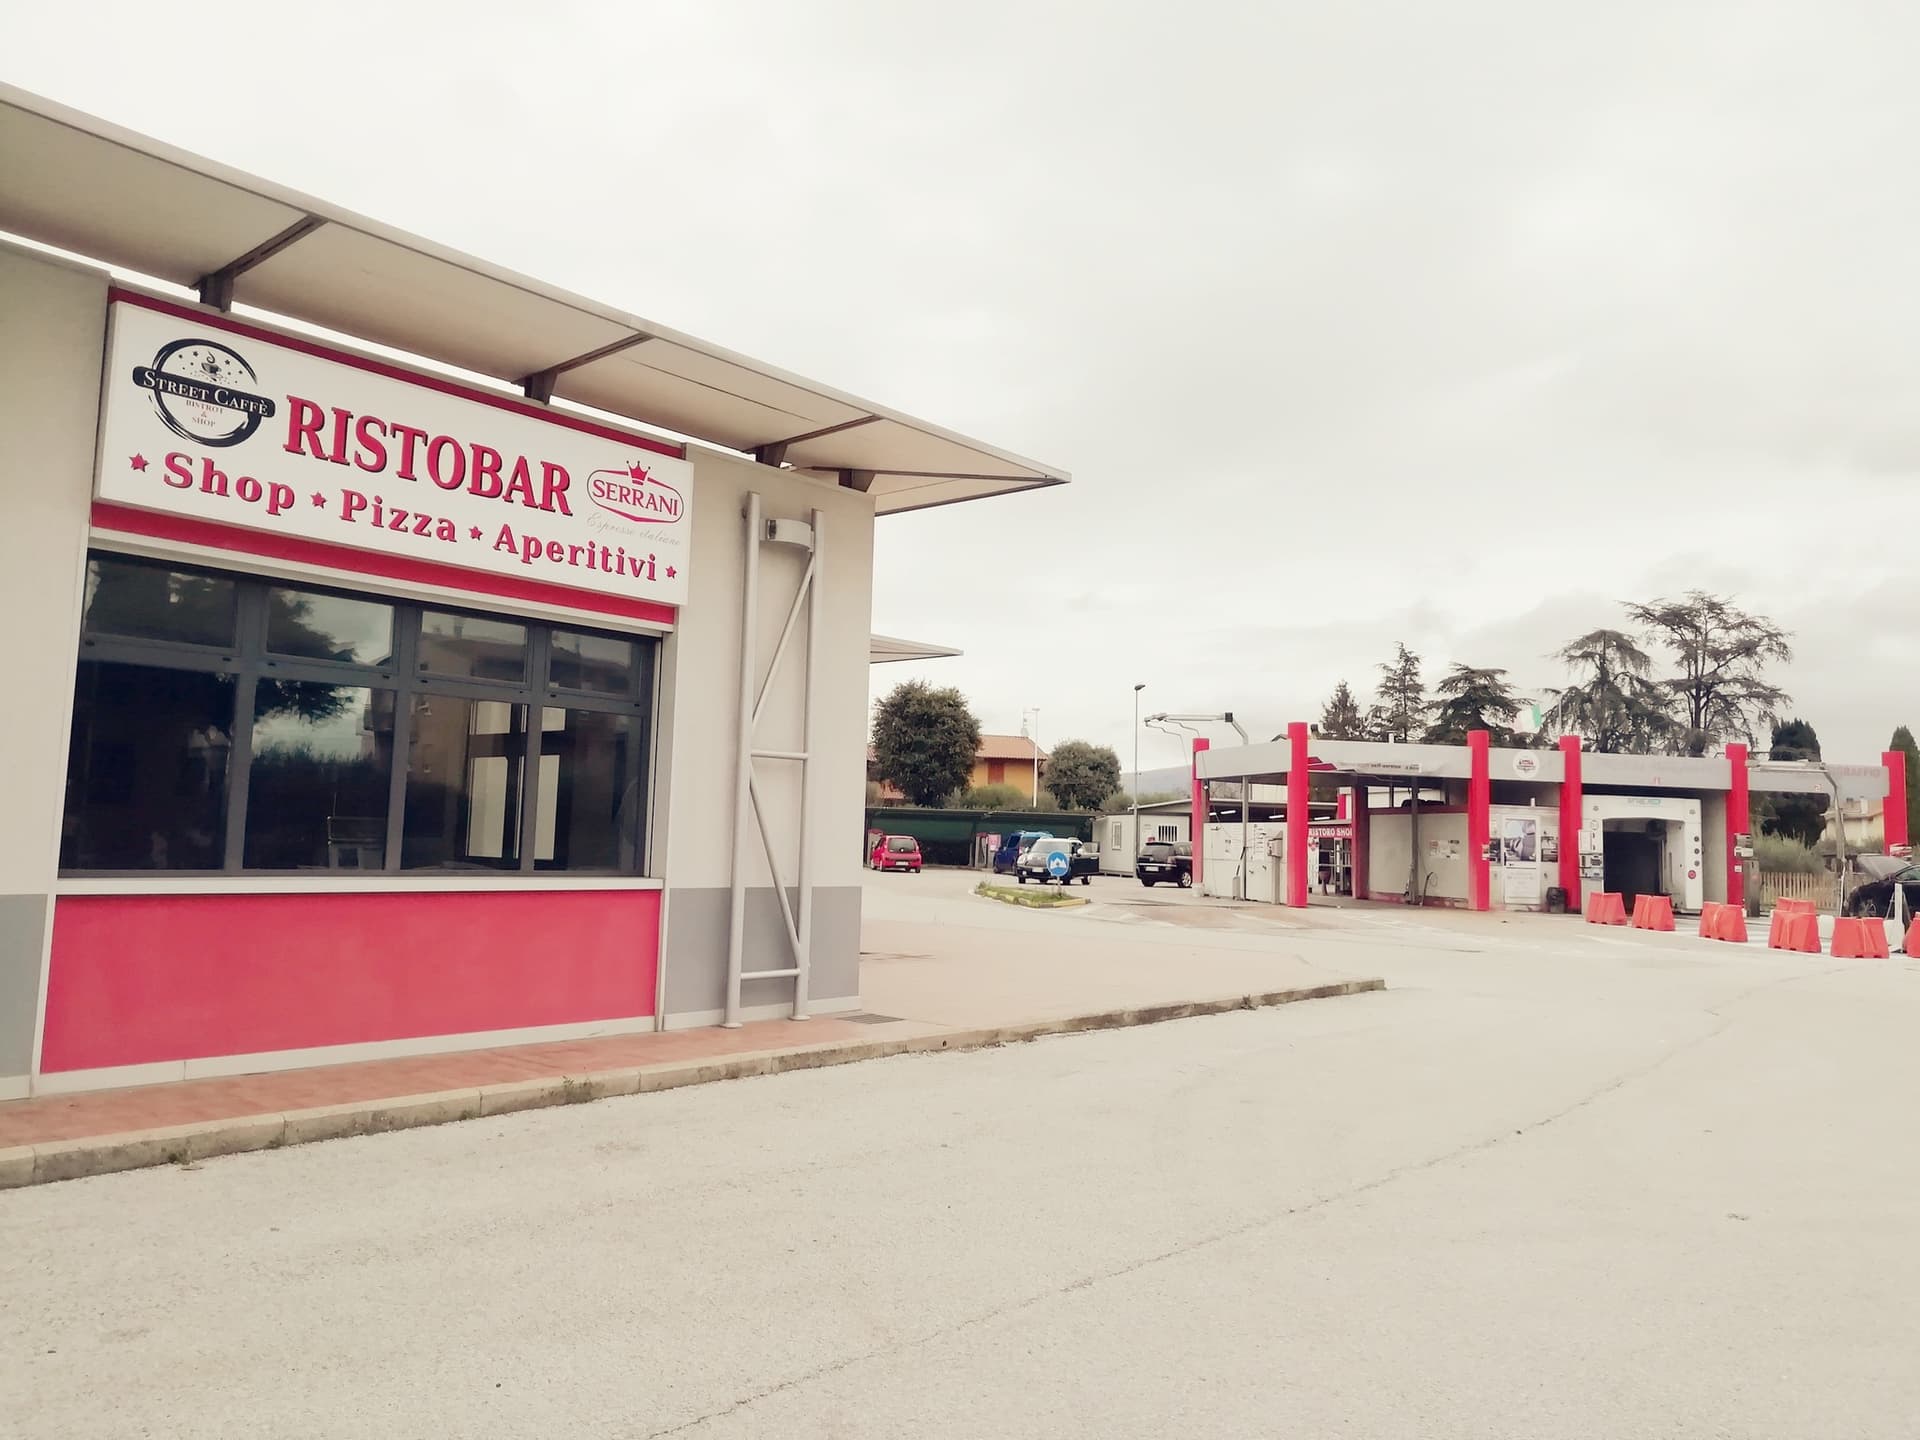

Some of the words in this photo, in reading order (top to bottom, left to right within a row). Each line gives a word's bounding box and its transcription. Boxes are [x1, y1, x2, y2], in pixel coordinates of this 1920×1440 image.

[143, 370, 210, 401] STREET
[191, 415, 216, 427] SHOP
[282, 394, 574, 516] RISTOBAR
[592, 479, 678, 516] SERRANI
[163, 452, 296, 516] Shop
[338, 488, 458, 543] Pizza
[492, 523, 657, 582] Aperitivi
